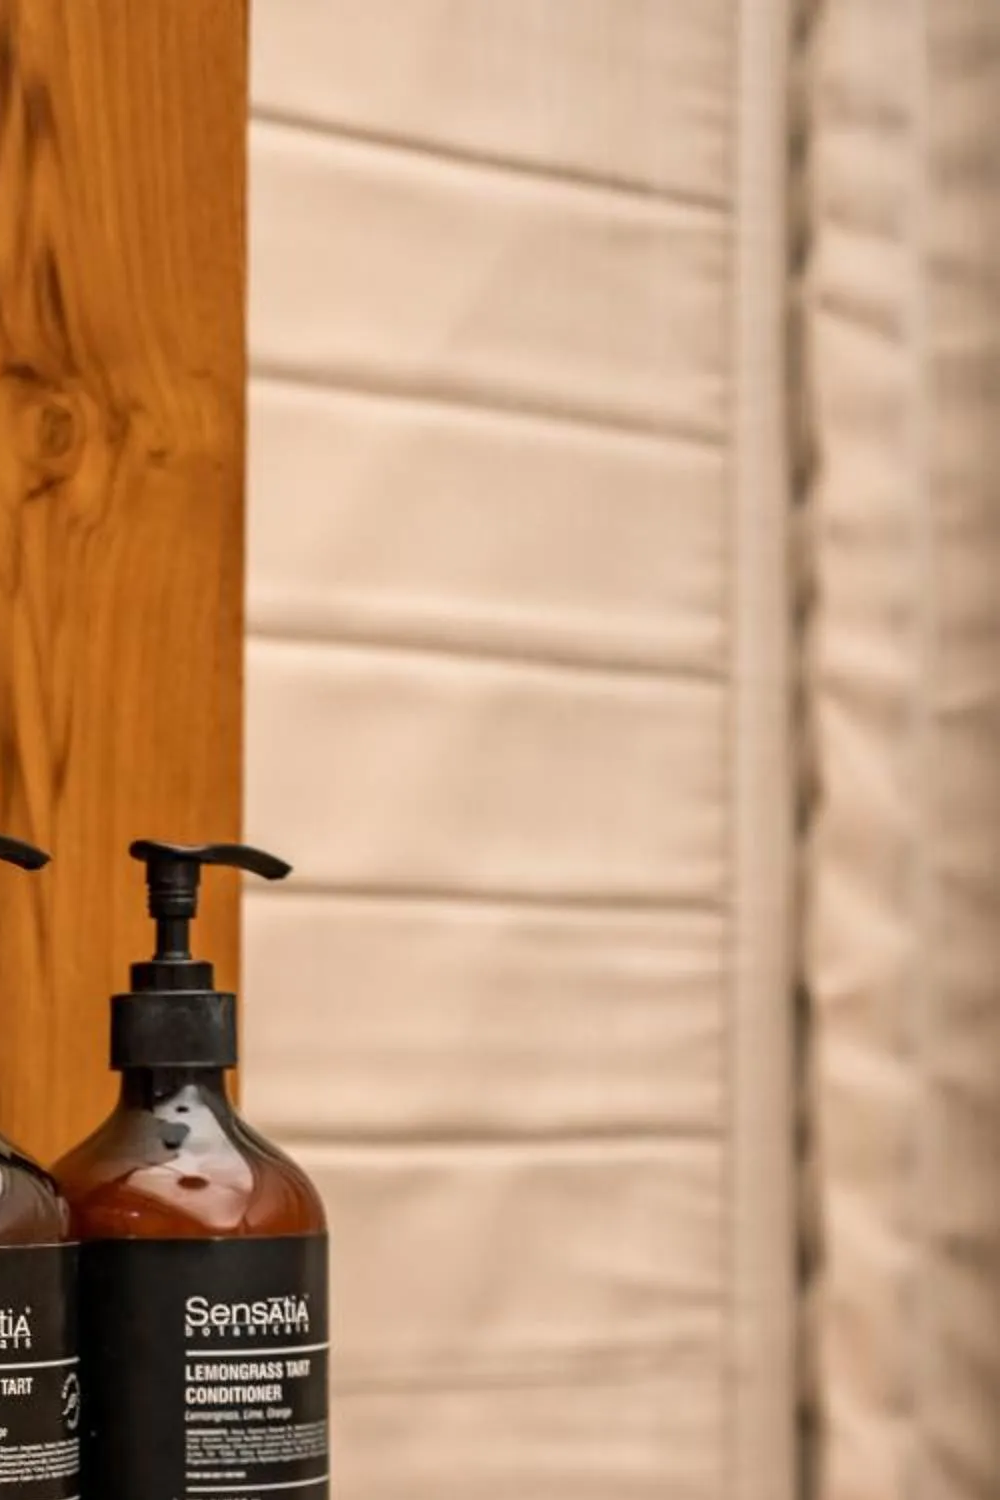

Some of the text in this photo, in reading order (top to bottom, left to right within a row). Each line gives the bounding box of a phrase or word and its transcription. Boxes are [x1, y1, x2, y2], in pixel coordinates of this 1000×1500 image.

[185, 1361, 284, 1382] LEMONGRASS
[0, 1377, 33, 1395] TART
[185, 1384, 283, 1405] CONDITIONER
